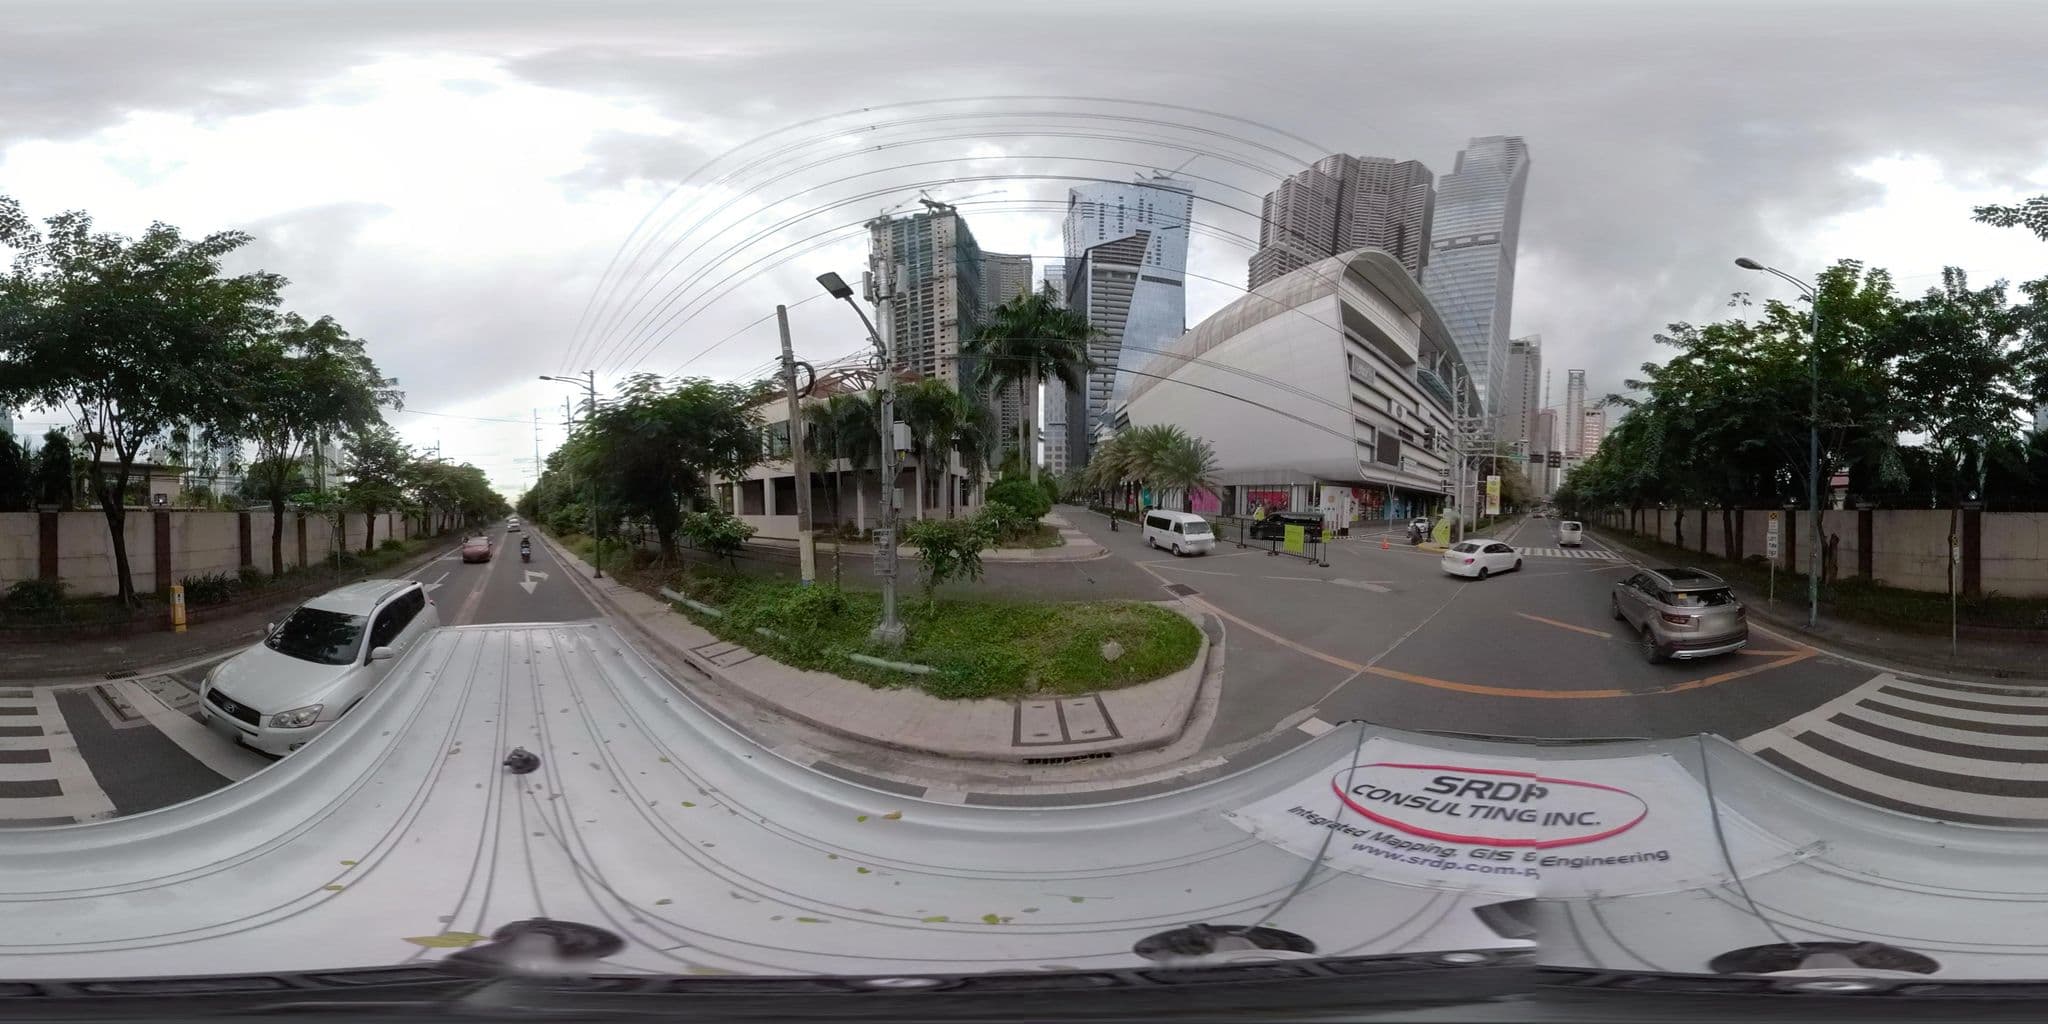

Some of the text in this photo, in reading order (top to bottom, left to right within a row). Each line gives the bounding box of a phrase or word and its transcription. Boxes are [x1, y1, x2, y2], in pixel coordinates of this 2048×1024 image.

[1353, 784, 1602, 827] CONSULTING INC.
[1423, 776, 1548, 803] SRDP
[1287, 806, 1369, 837] Integrated
[1468, 848, 1515, 862] GIS
[1540, 850, 1671, 869] Engineering
